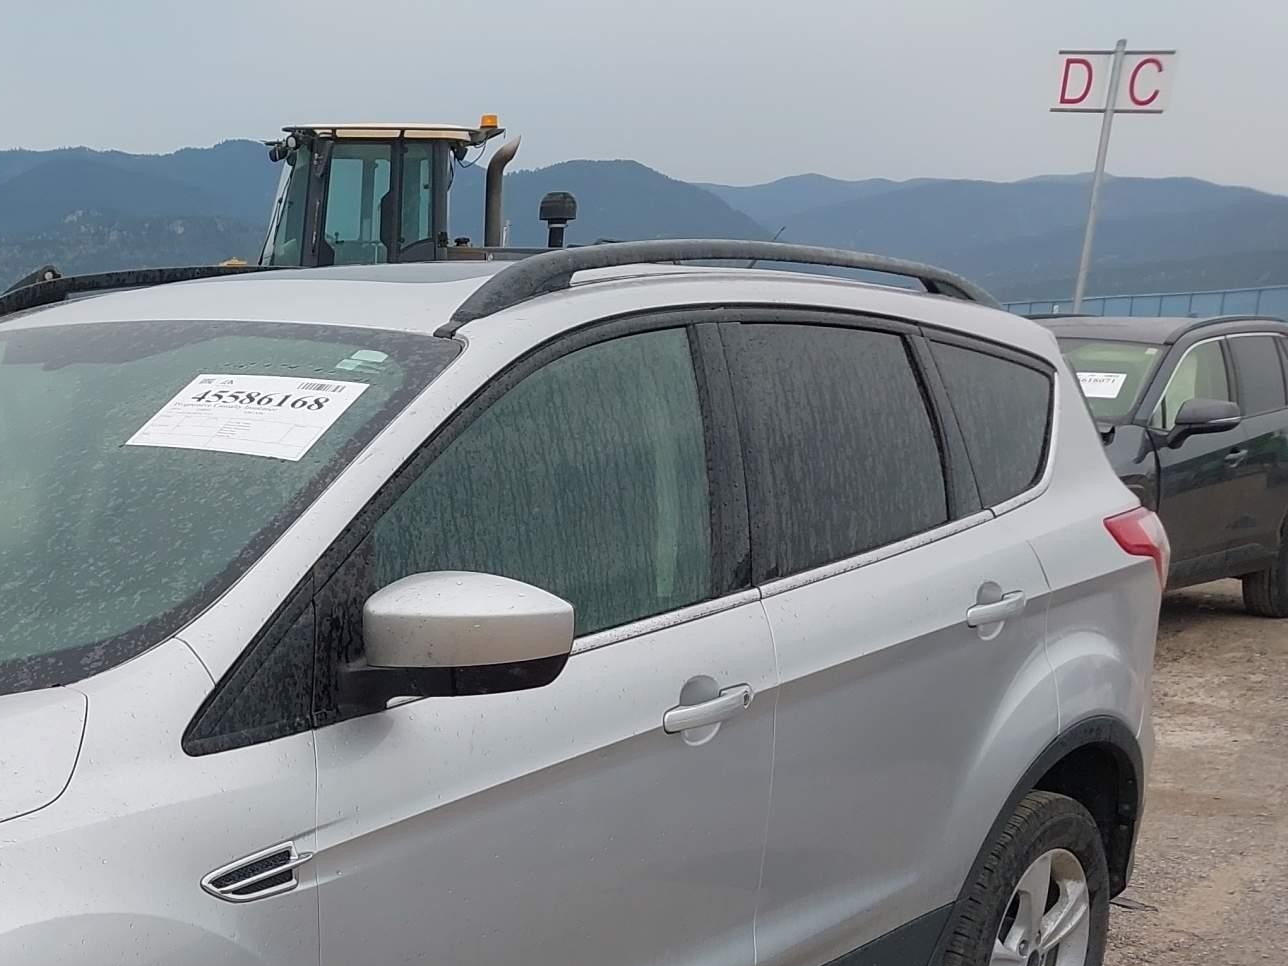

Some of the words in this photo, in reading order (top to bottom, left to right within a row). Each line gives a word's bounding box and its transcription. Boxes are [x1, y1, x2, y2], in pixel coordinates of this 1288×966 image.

[1059, 58, 1093, 104] D
[1129, 58, 1163, 106] C
[192, 389, 330, 411] 45586168
